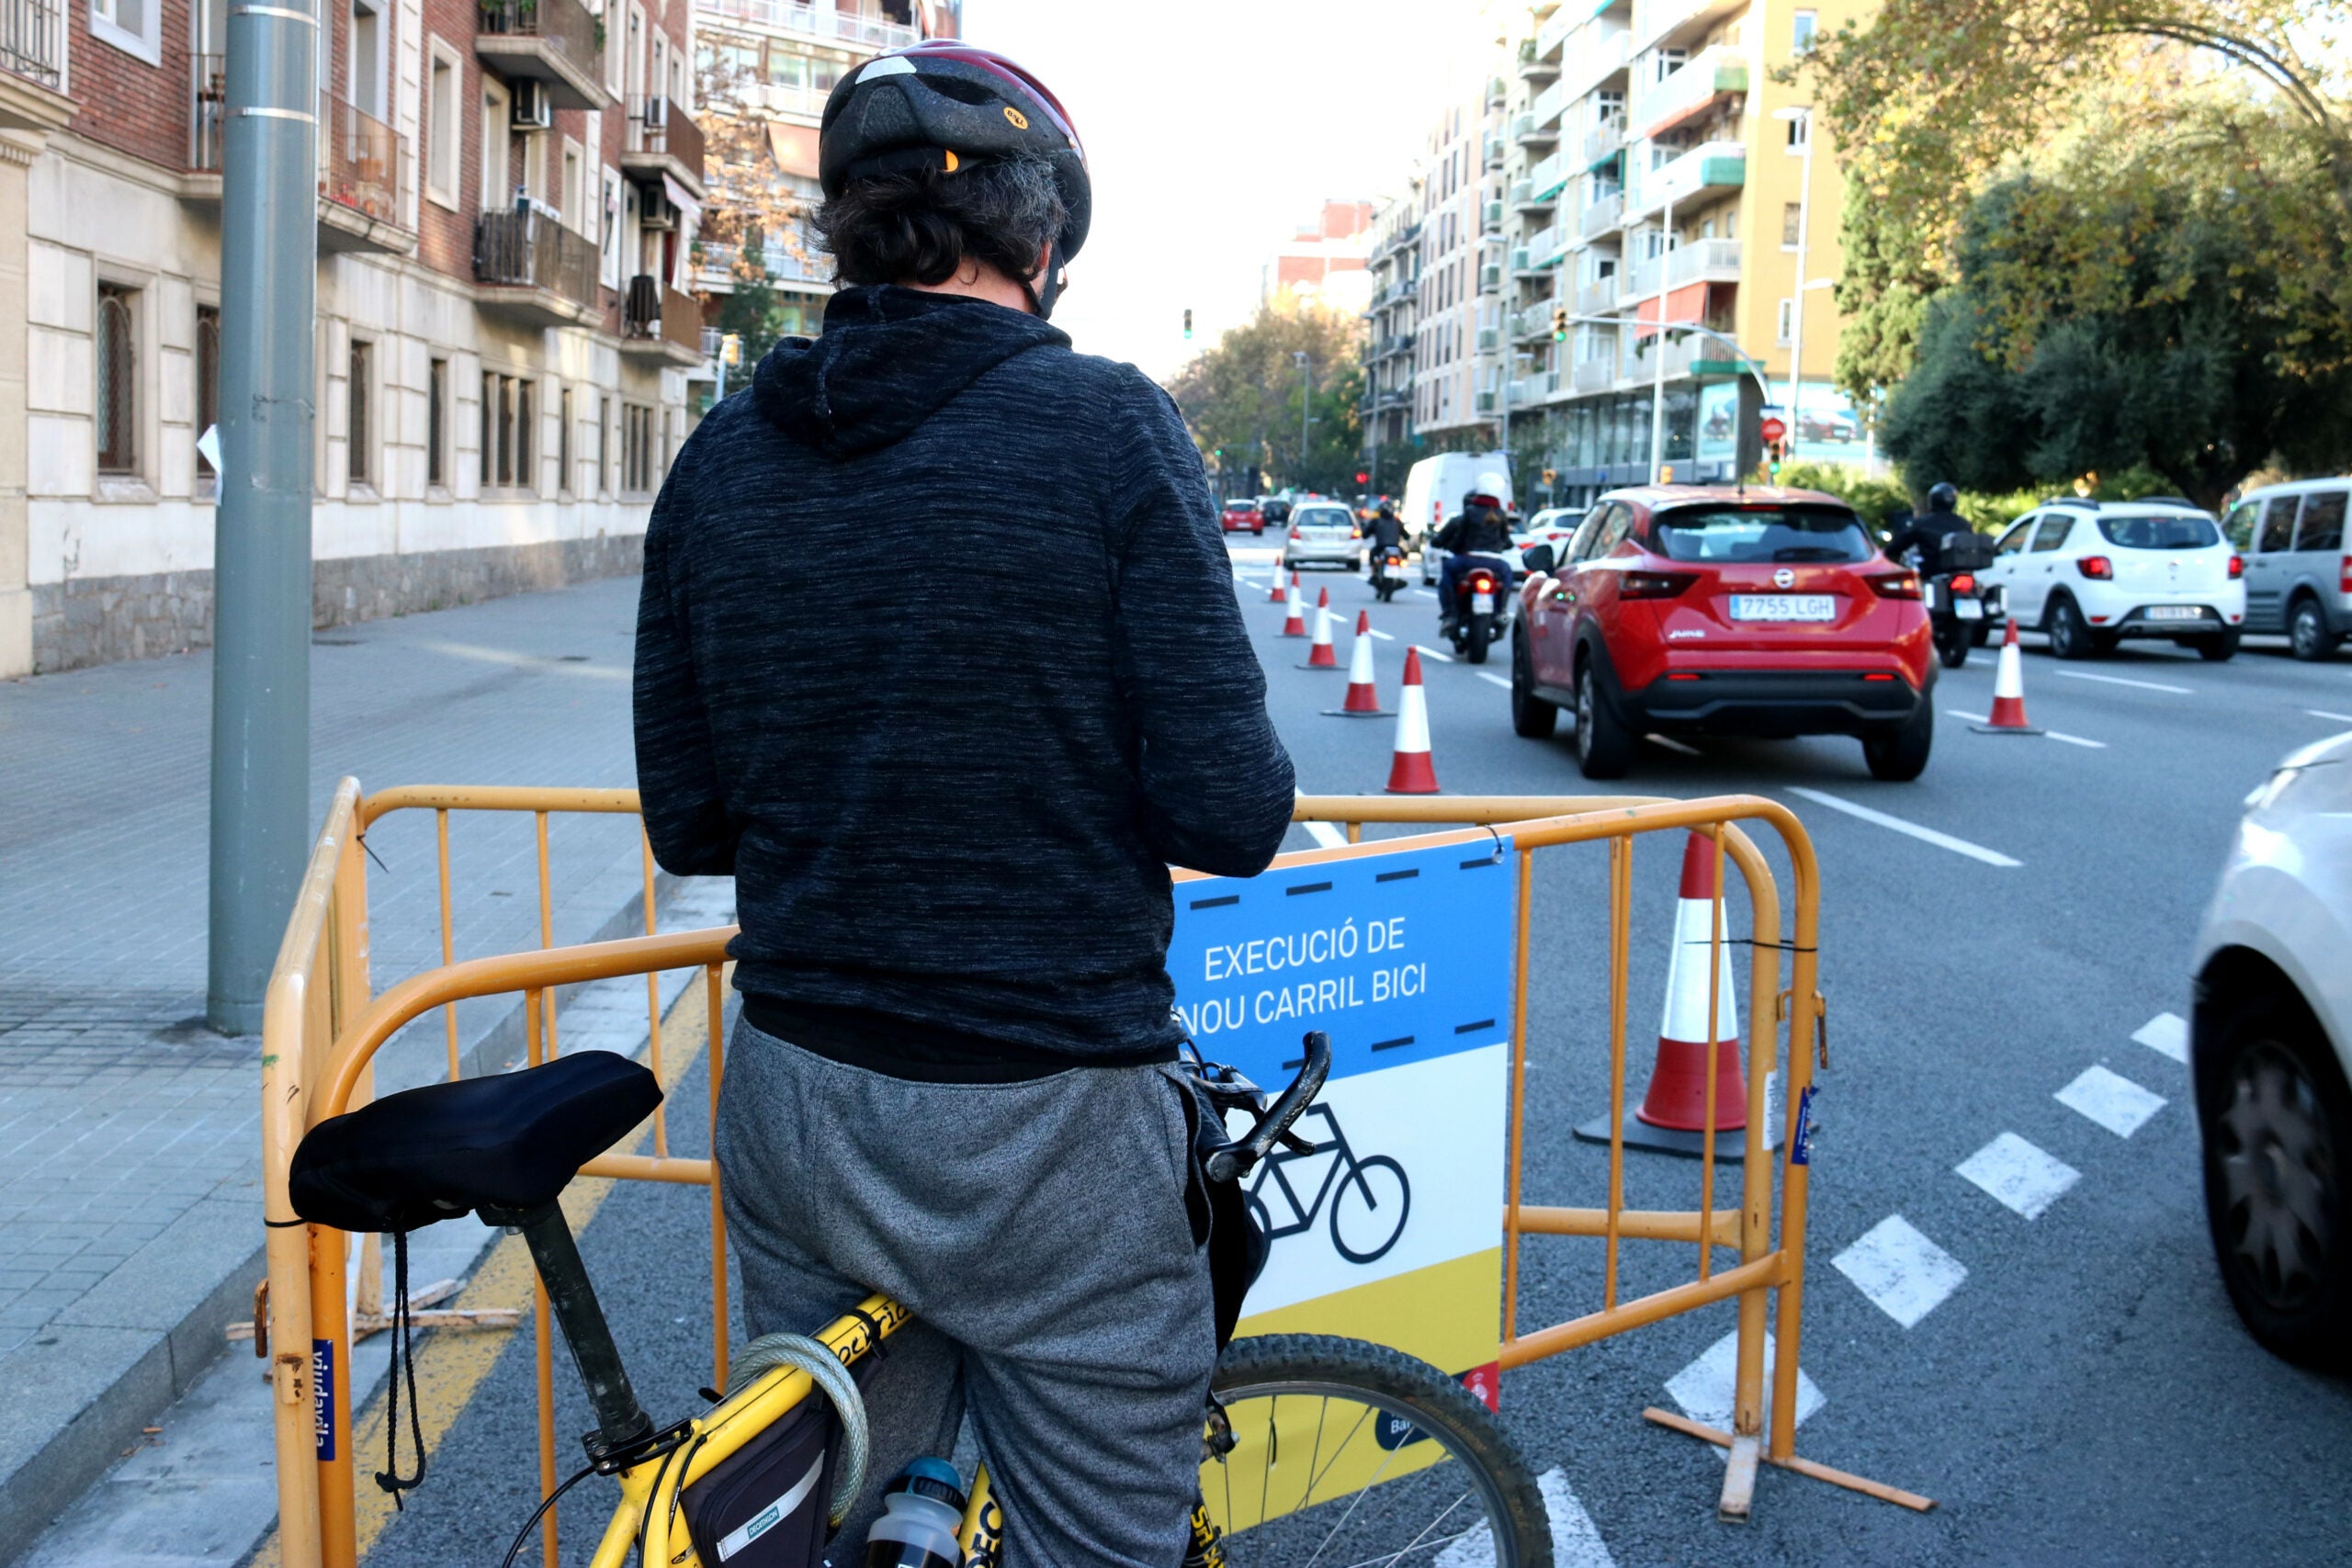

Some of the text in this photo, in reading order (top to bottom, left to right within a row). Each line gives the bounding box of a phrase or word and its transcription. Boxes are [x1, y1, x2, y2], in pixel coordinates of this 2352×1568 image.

[1743, 598, 1831, 615] 7755 LGH
[1204, 917, 1406, 982] EXECUCIÓ DE
[1178, 963, 1426, 1037] NOU CARRIL BICI
[749, 1508, 778, 1536] DECATHLON
